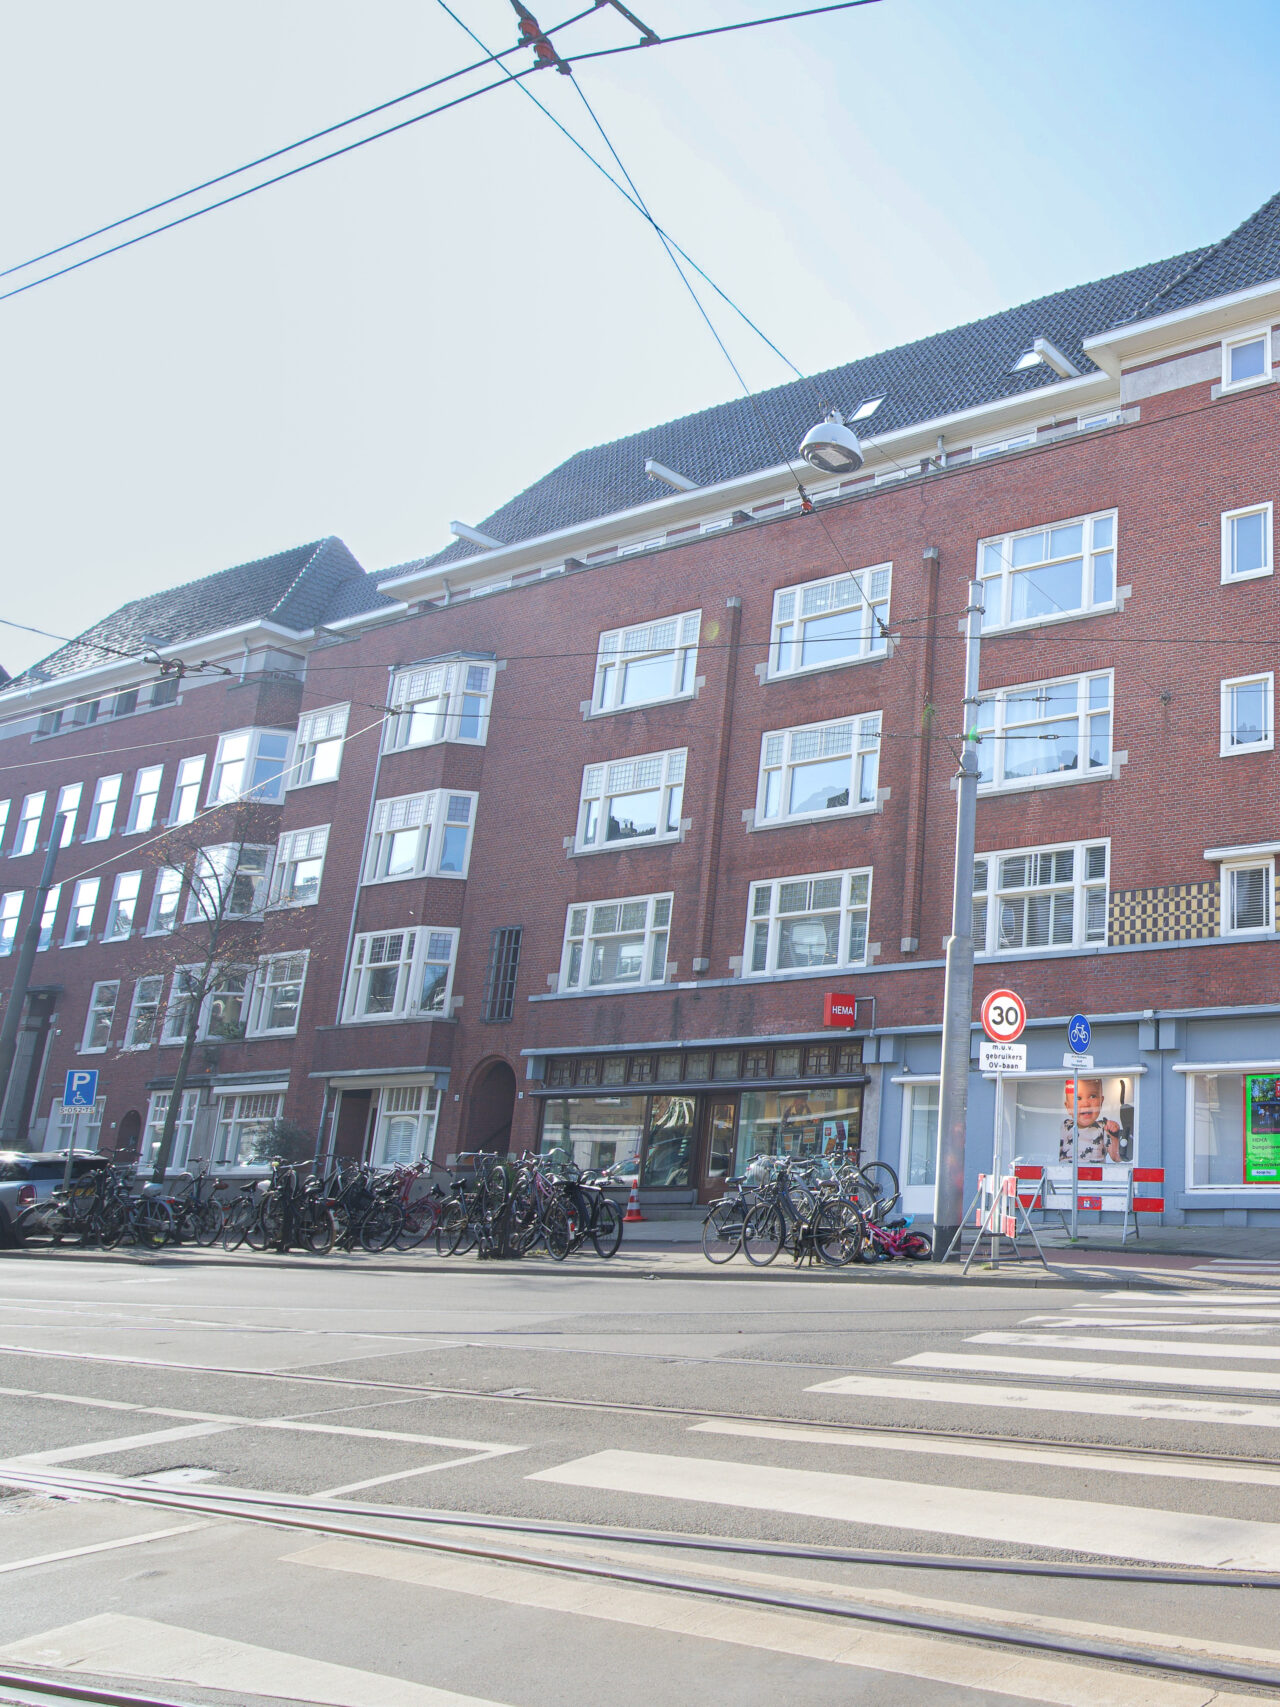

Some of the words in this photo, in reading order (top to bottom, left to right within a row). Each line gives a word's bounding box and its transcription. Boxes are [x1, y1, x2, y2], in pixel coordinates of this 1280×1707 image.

[832, 1005, 854, 1015] HEMA
[992, 1006, 1018, 1025] 30
[985, 1053, 1023, 1062] gebruikers
[72, 1072, 91, 1091] P
